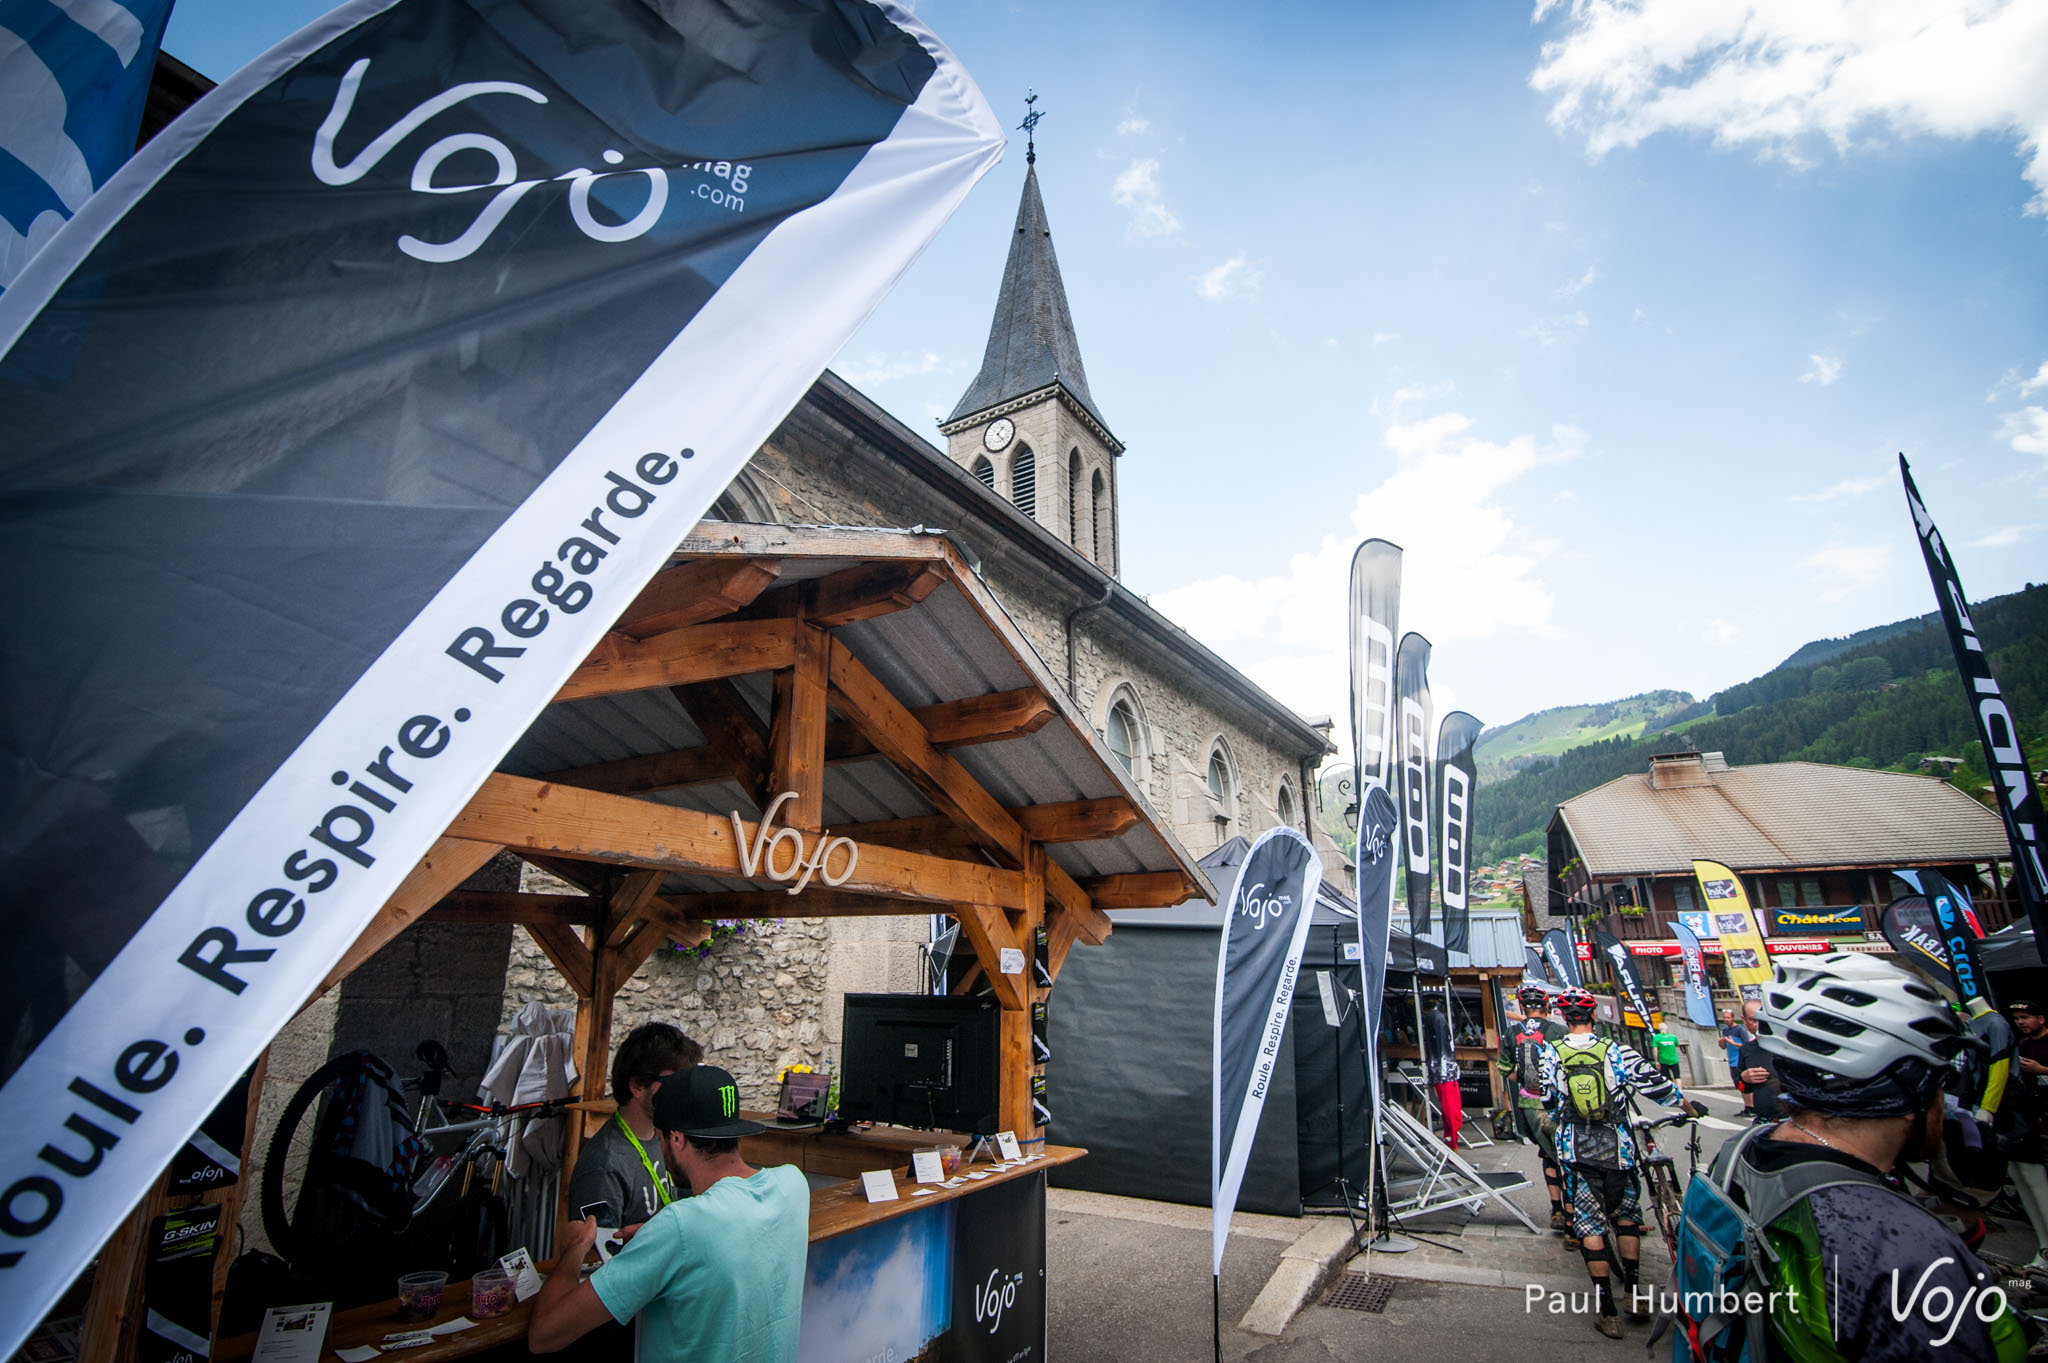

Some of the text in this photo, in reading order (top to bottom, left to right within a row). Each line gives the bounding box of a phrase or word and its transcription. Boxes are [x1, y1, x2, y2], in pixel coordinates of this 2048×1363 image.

[691, 184, 744, 212] .com
[0, 446, 696, 1270] oule. Respire. Regarde.
[730, 792, 859, 895] Vojo
[1241, 883, 1282, 930] Vojo
[1773, 943, 1824, 952] SOUVENIRS
[1252, 955, 1299, 1100] Roule. Respire. Regarde.
[976, 1268, 1016, 1334] Vojo
